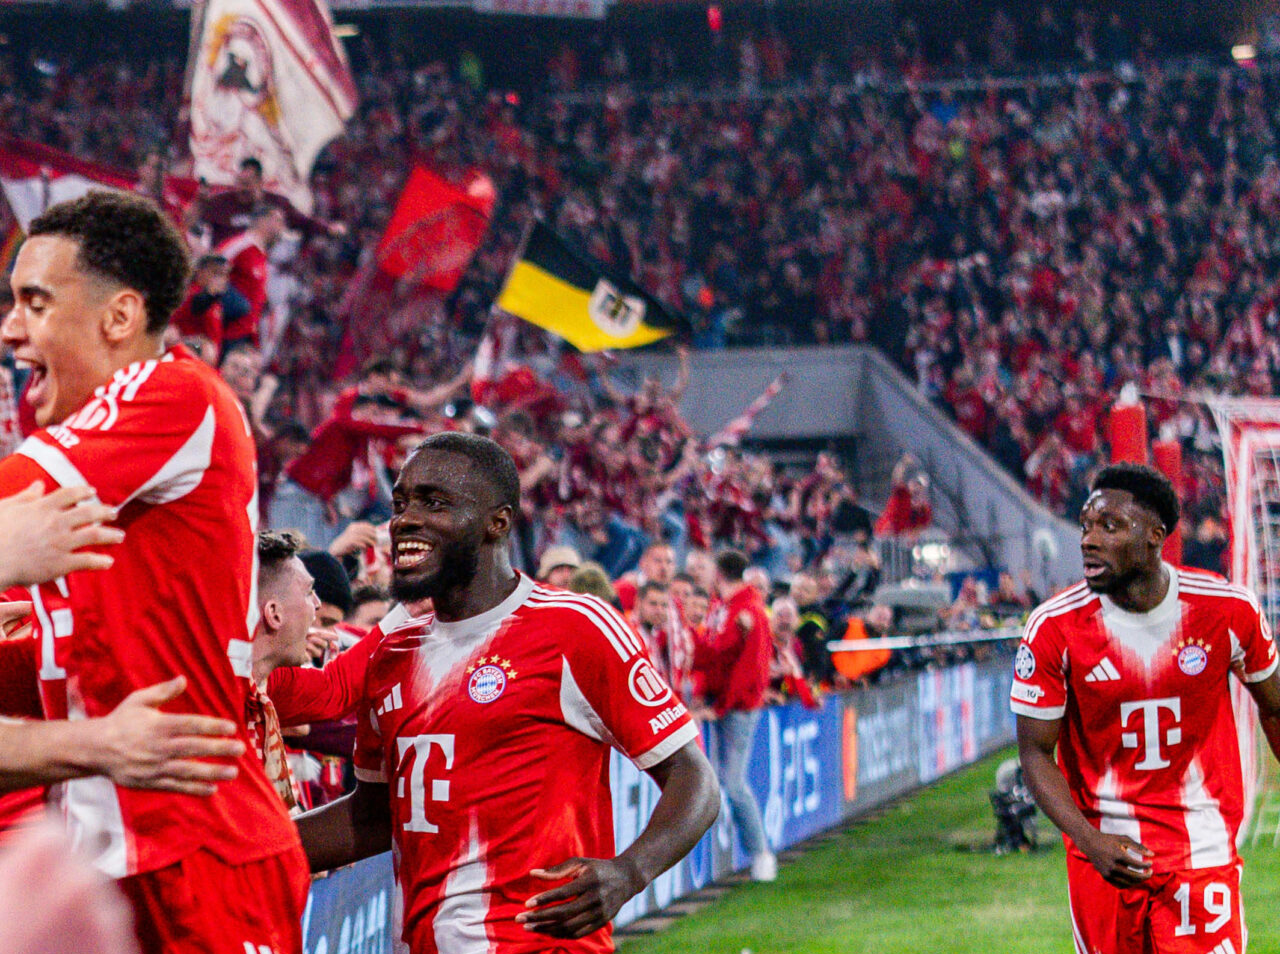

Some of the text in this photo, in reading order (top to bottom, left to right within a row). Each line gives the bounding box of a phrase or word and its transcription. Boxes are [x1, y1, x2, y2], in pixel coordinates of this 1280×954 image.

[1121, 697, 1182, 771] T
[395, 733, 456, 834] T
[1173, 882, 1232, 937] 19
